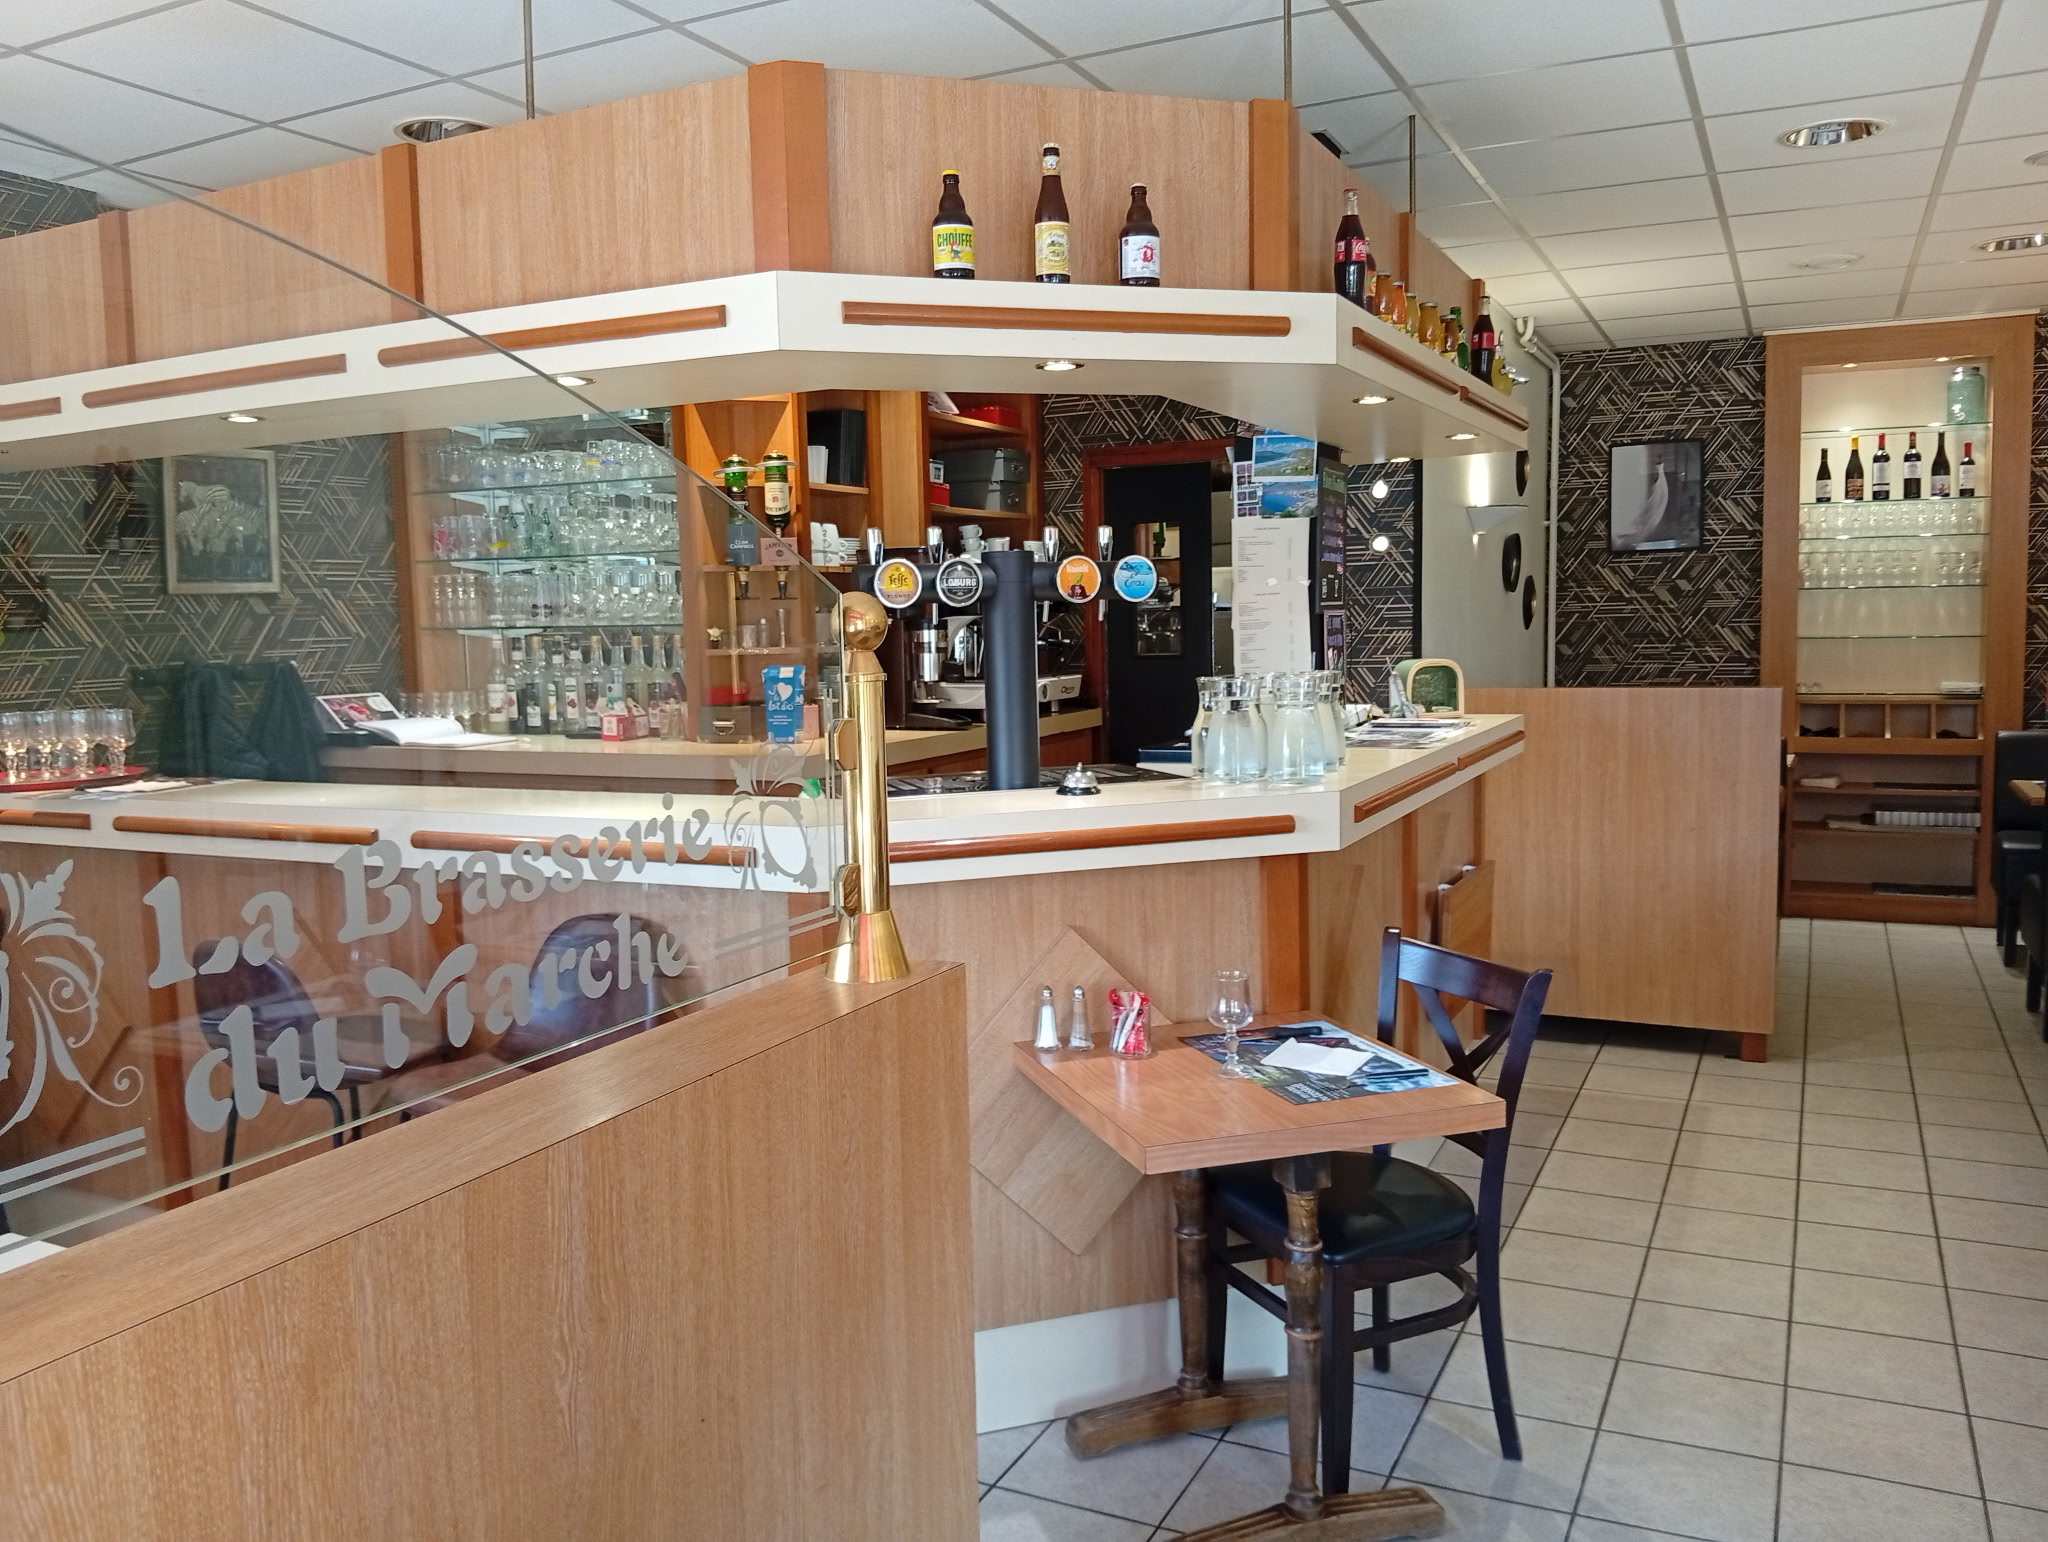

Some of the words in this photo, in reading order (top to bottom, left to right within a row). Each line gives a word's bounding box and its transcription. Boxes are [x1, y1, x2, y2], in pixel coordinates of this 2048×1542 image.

[937, 232, 973, 248] CHOUFFE
[888, 572, 908, 588] Leffe
[943, 578, 977, 587] LOBURG
[142, 875, 301, 989] La
[334, 791, 713, 944] Brasserie
[184, 1004, 346, 1133] du
